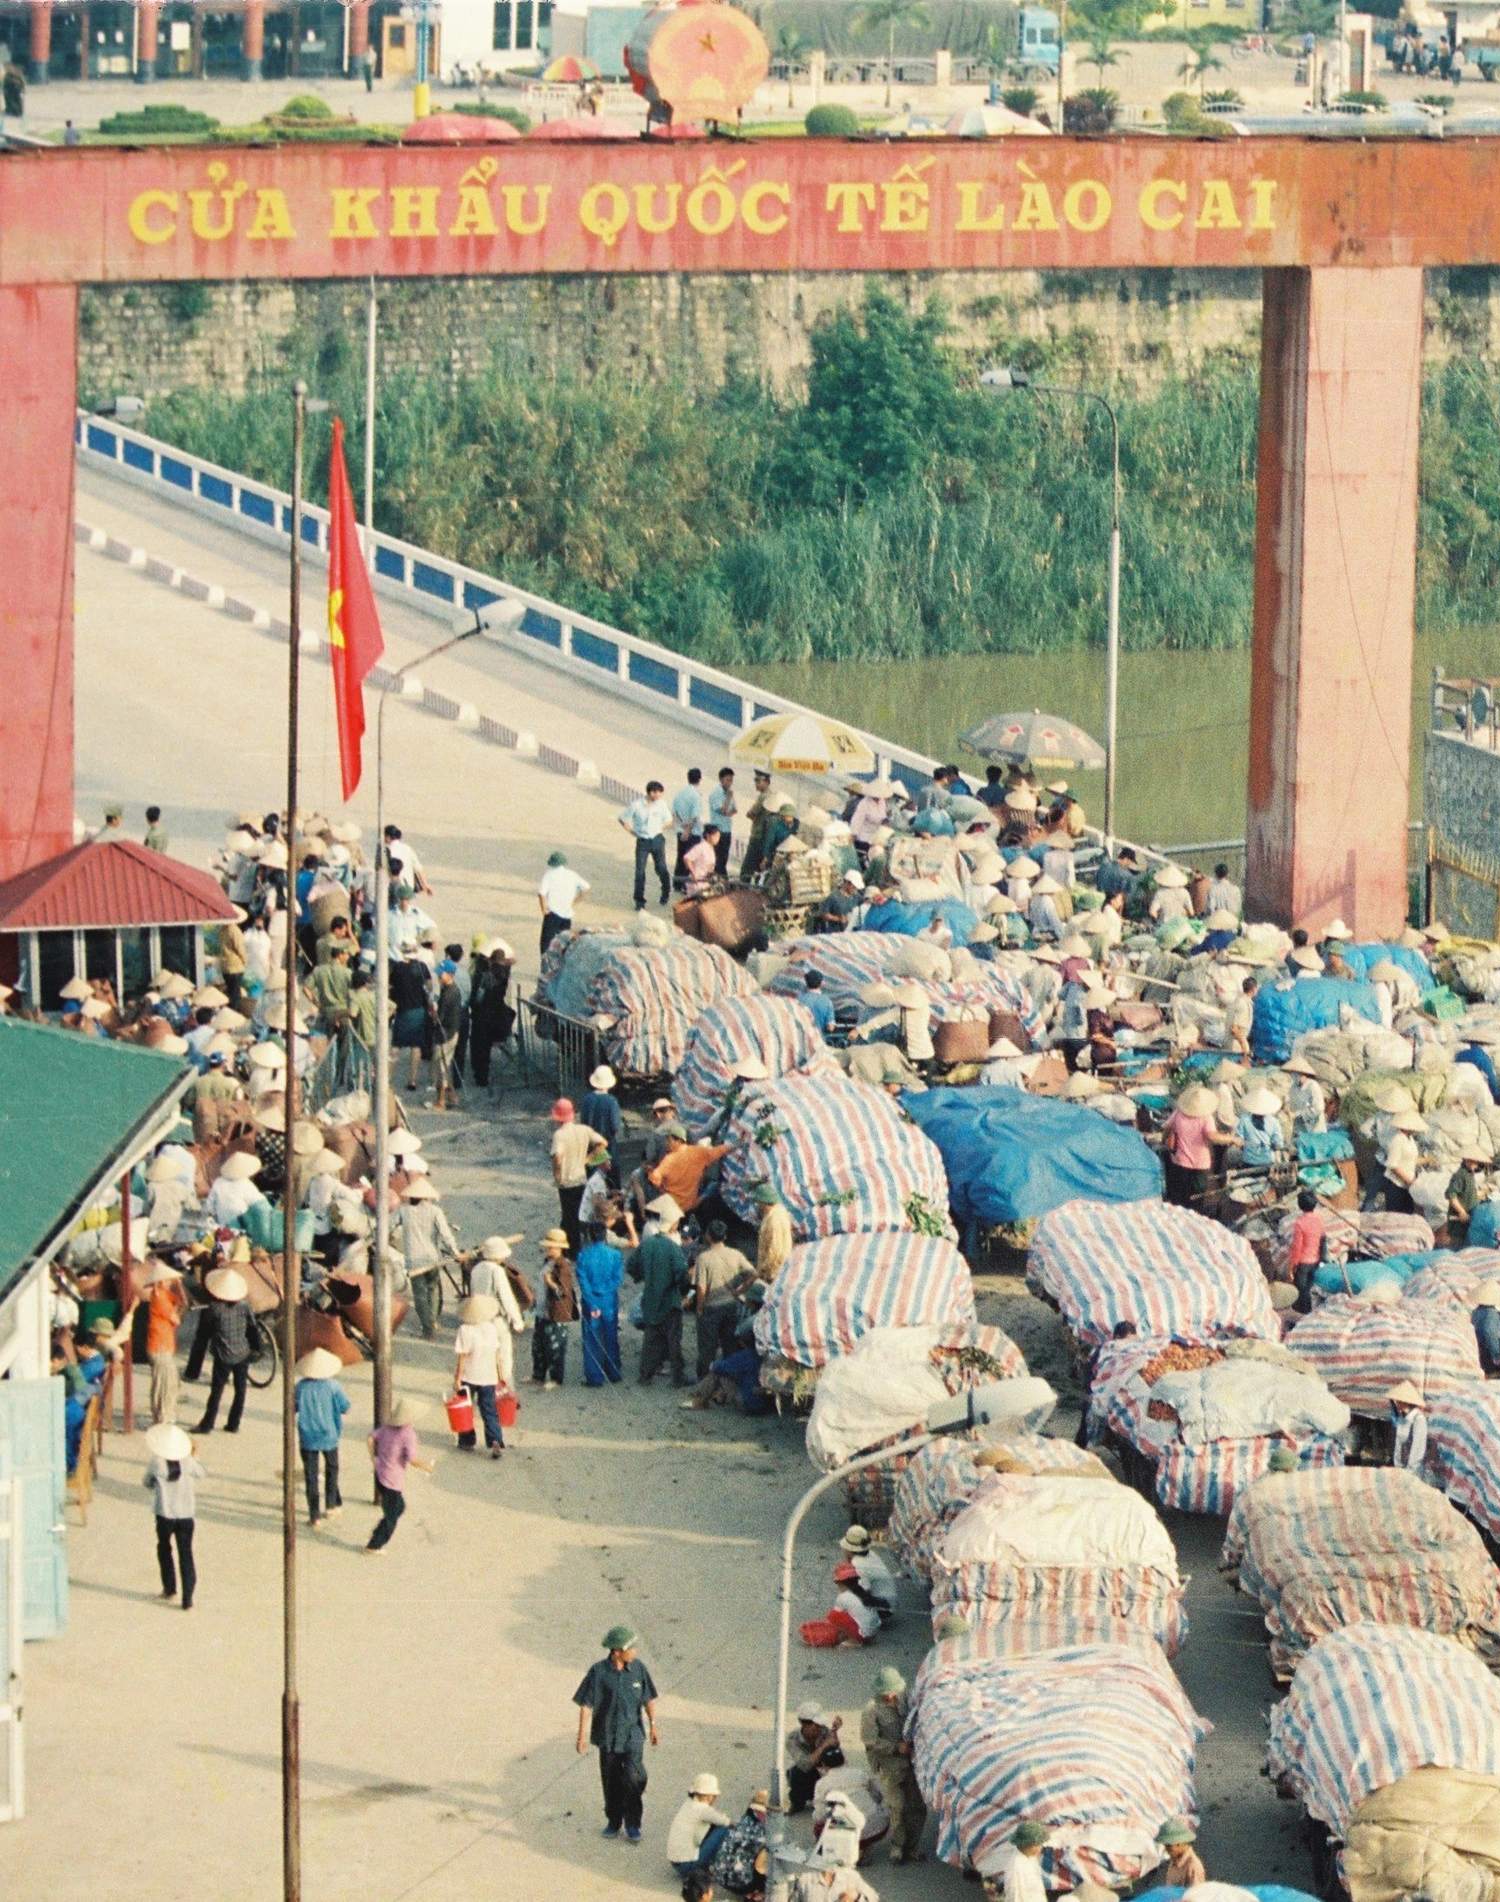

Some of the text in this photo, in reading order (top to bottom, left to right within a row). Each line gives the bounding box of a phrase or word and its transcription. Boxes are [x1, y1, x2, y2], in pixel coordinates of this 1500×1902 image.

[127, 154, 1278, 247] CỬA KHẨU QUỐC TẾ LÀO CAI
